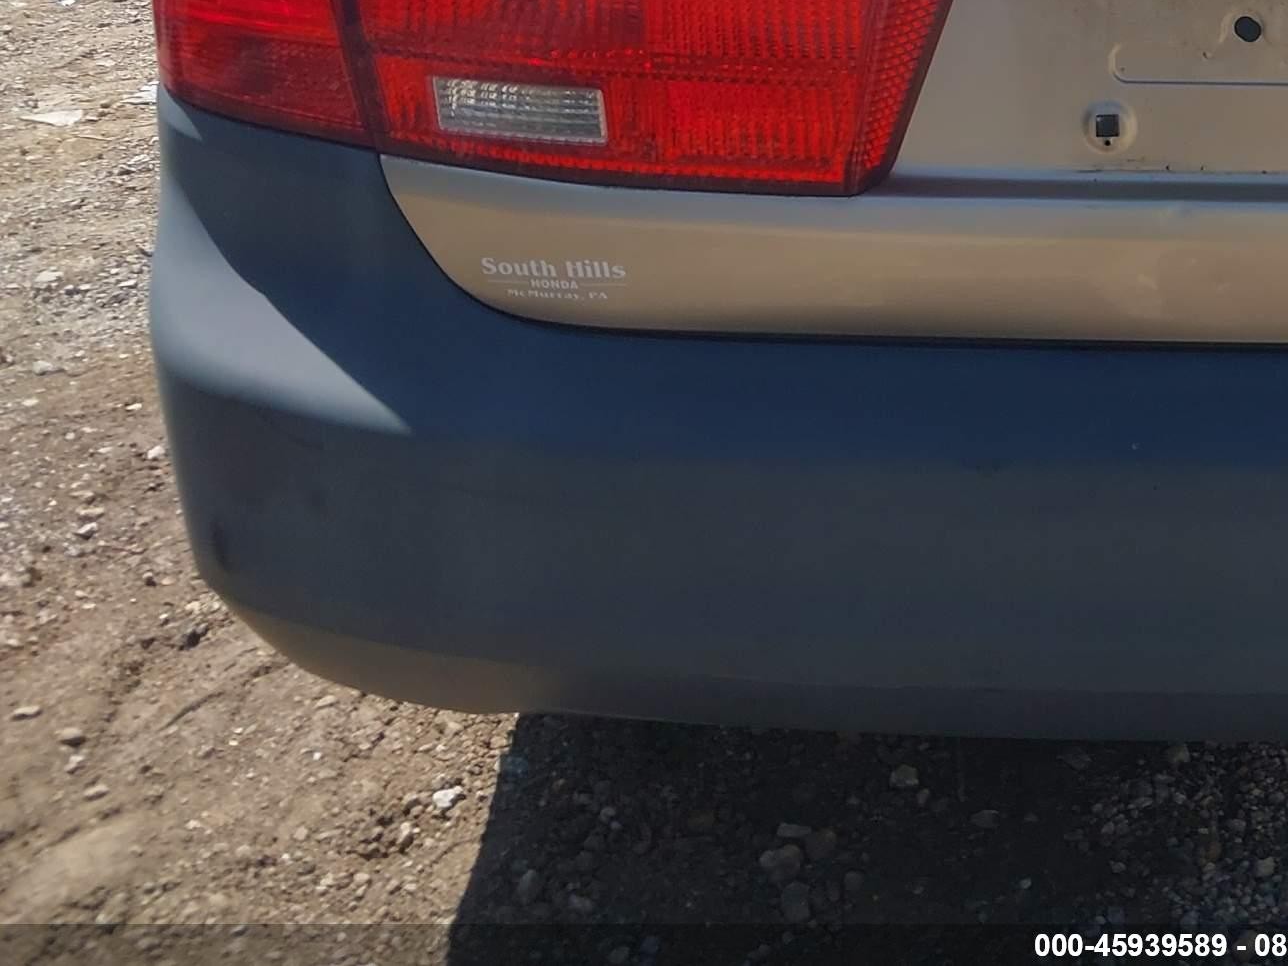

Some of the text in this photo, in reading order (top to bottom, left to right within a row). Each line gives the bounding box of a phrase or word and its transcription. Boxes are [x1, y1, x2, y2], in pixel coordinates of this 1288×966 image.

[480, 257, 627, 279] South Hills
[530, 278, 579, 290] HONDA
[588, 291, 608, 300] PA
